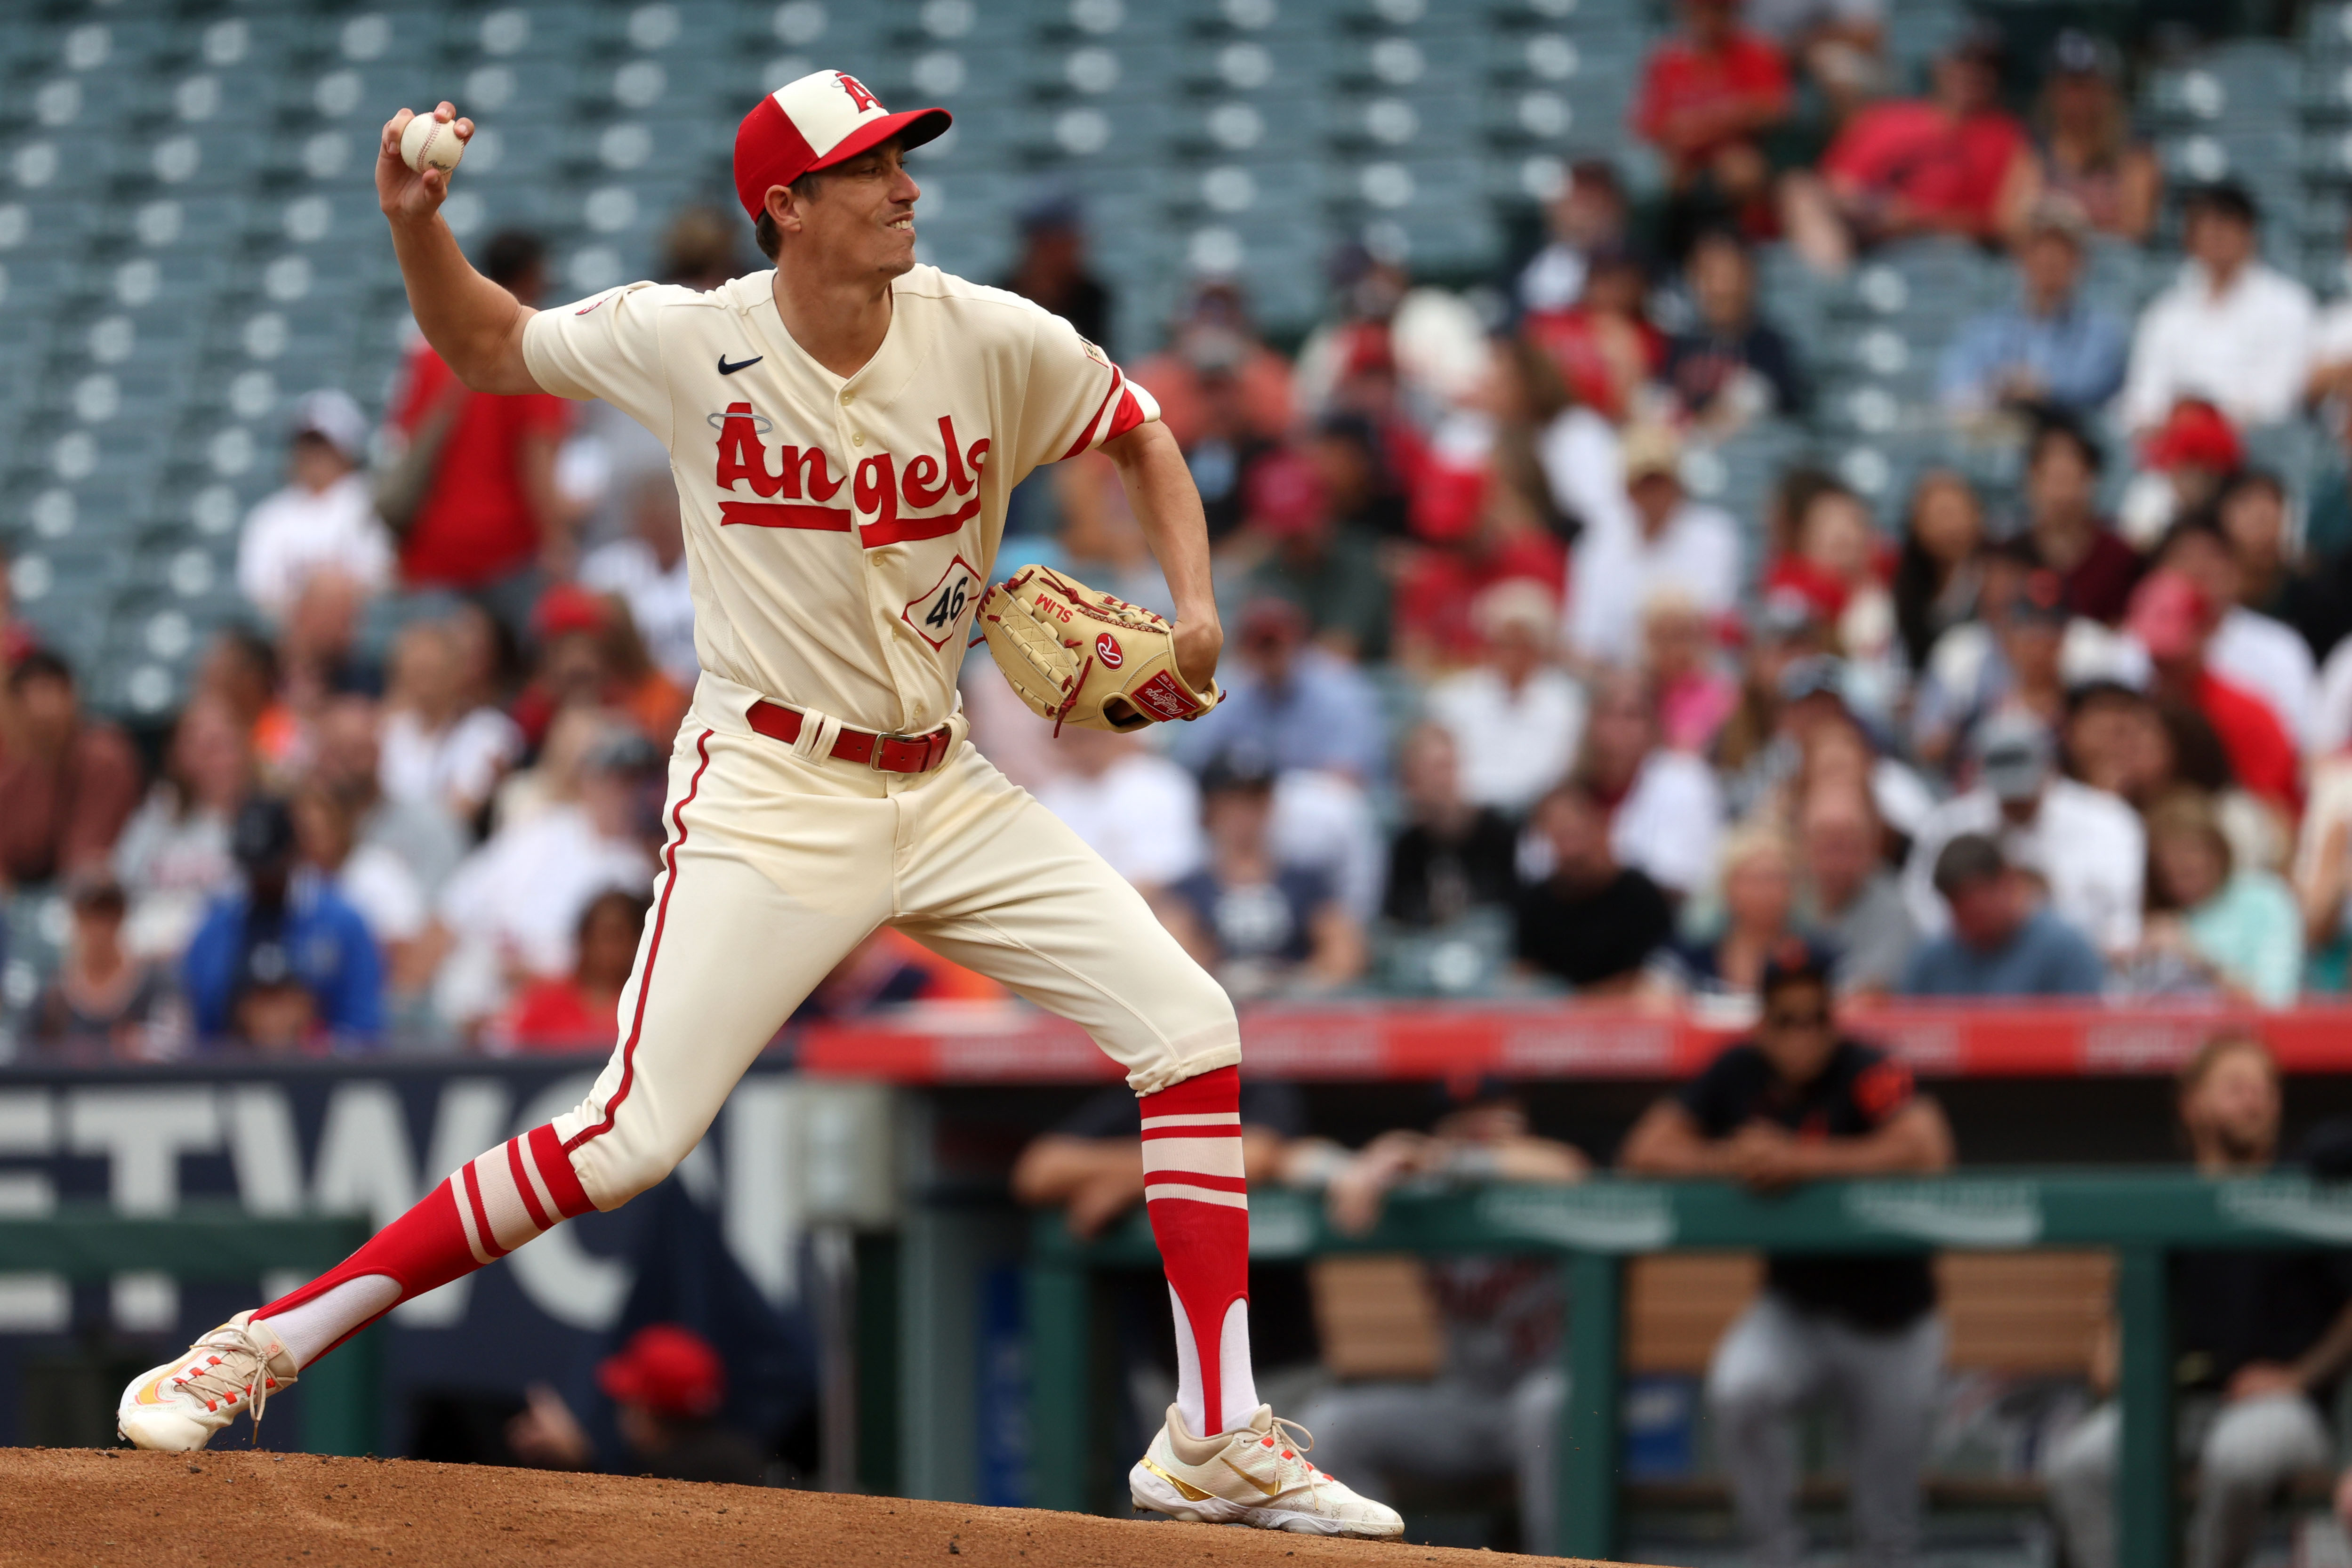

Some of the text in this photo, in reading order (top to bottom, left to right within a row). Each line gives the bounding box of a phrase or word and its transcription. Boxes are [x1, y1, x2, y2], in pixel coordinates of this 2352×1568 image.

[834, 72, 884, 113] A
[716, 402, 990, 549] Angels
[925, 576, 968, 629] 46
[1035, 593, 1073, 623] SLIM
[1098, 636, 1122, 665] R
[1145, 688, 1183, 715] Rawlings
